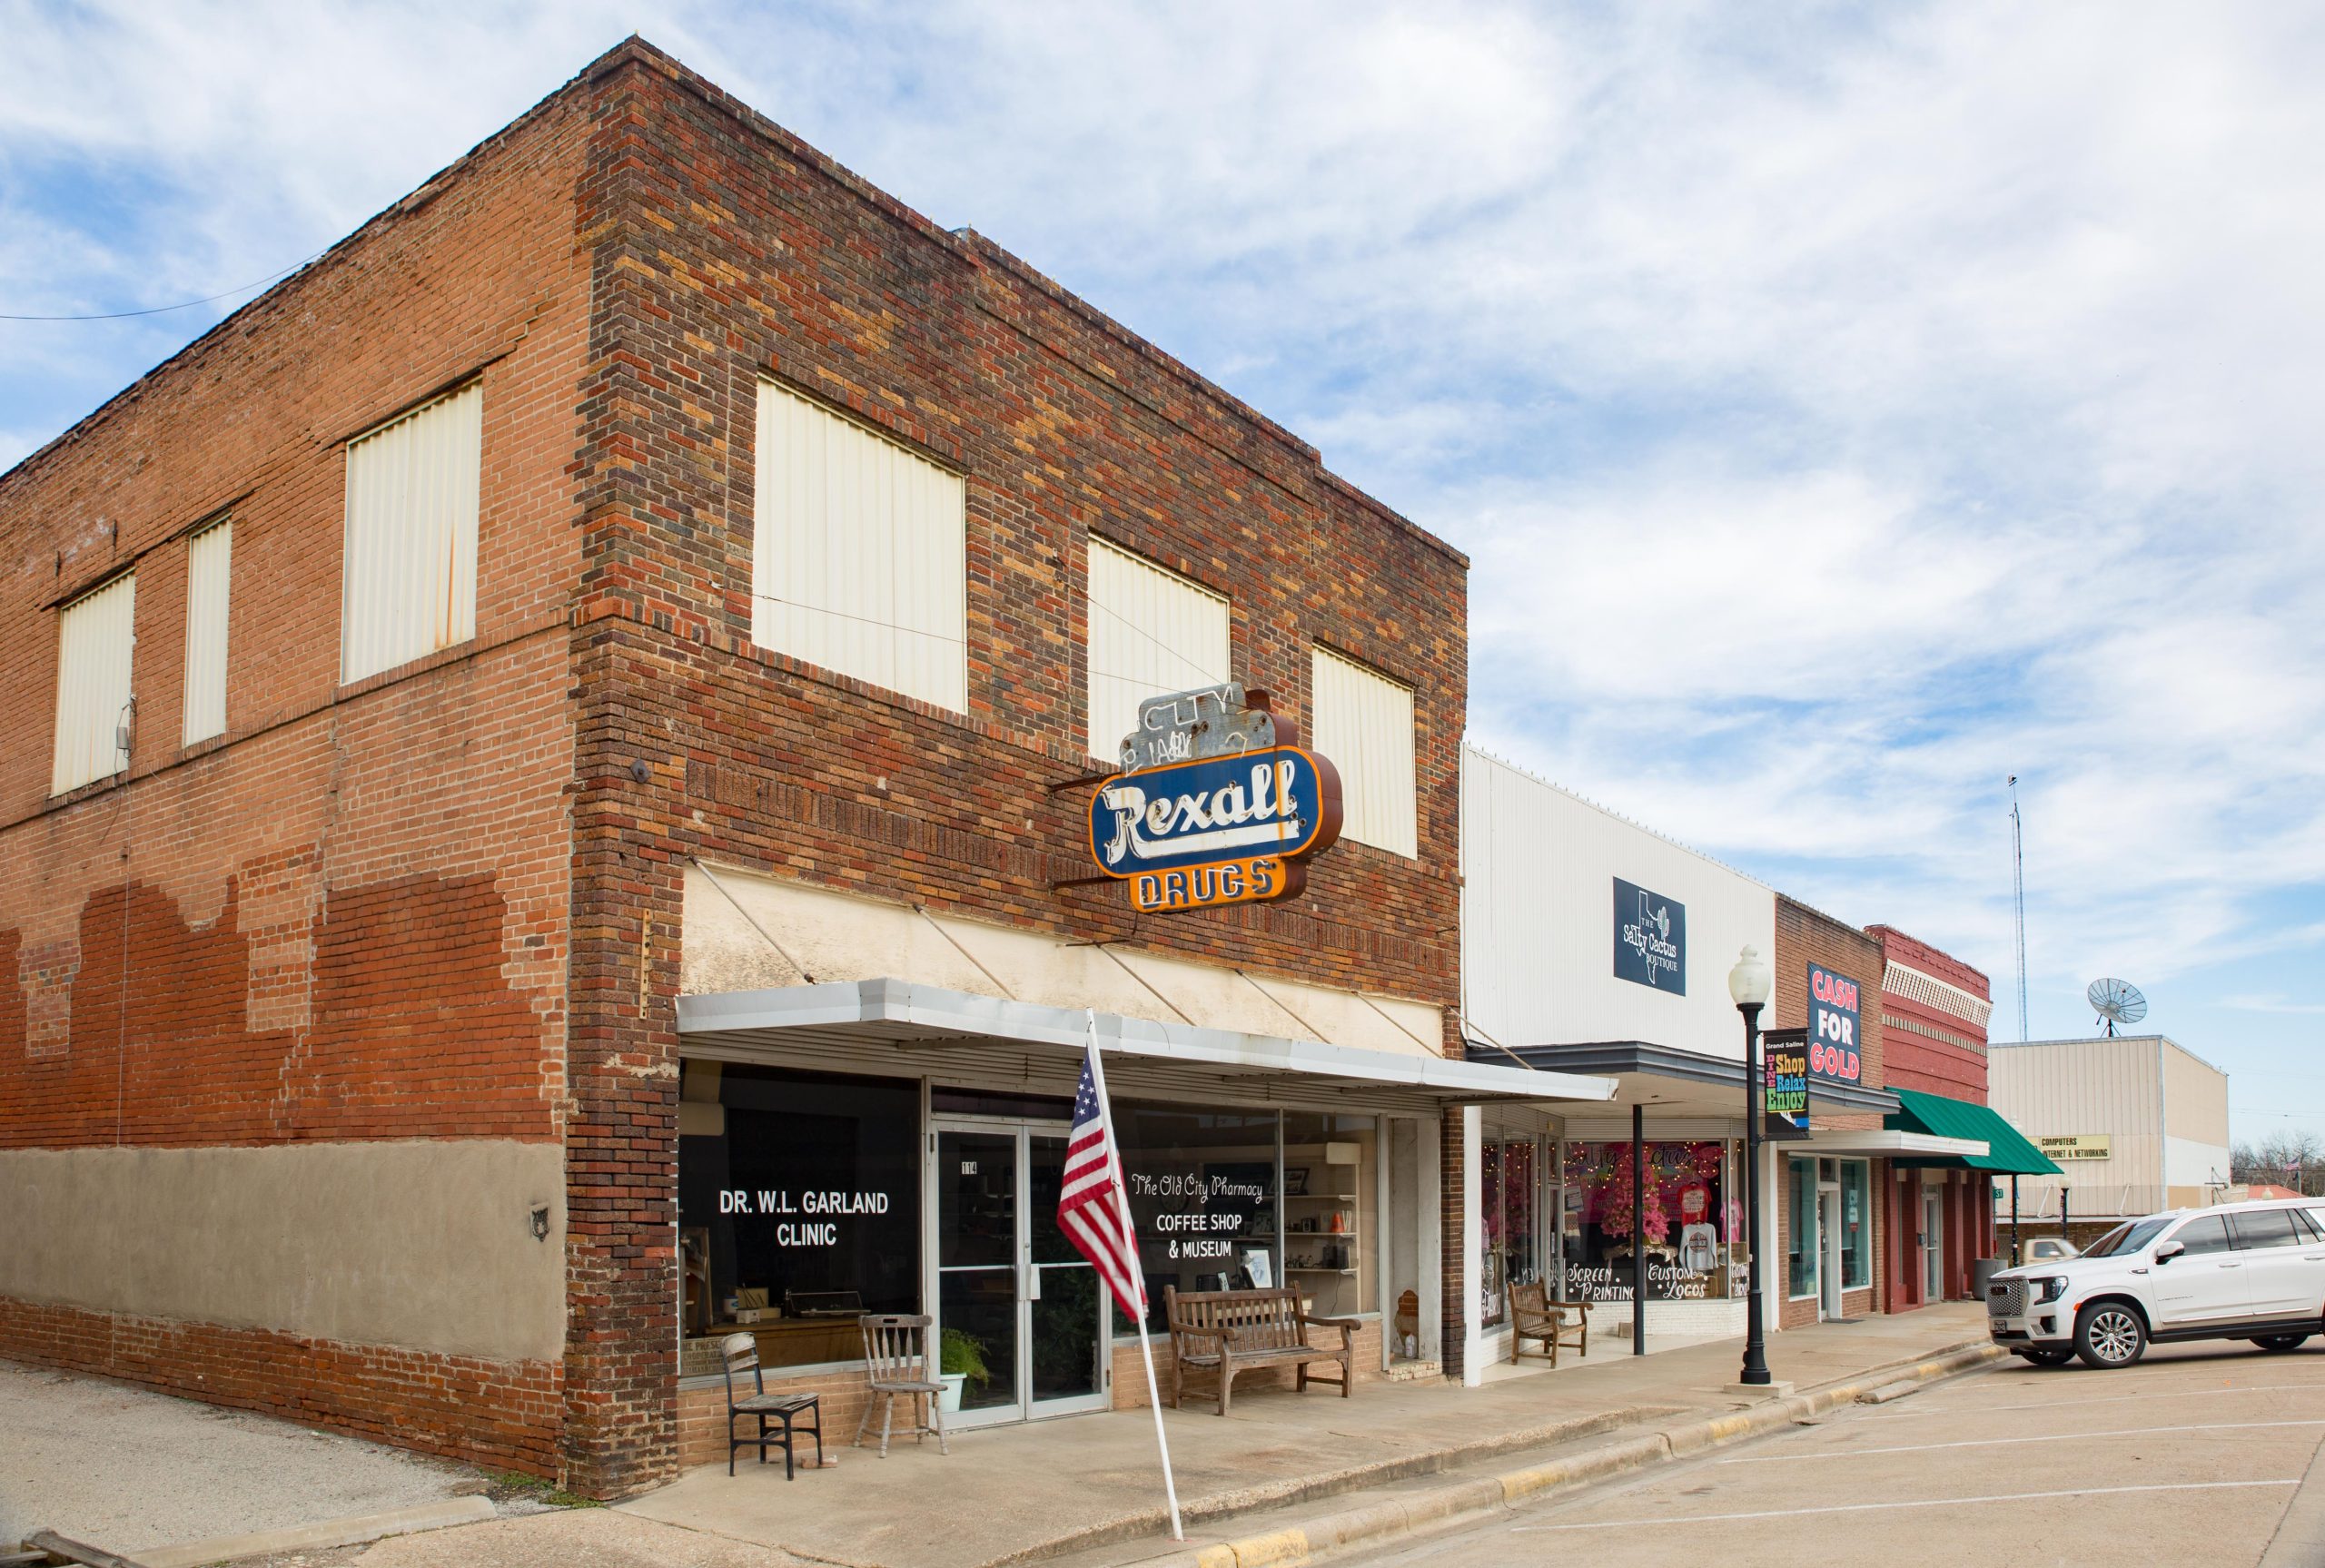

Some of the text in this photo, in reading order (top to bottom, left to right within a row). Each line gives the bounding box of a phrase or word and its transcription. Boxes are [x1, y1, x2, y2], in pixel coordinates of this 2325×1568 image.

[1101, 760, 1300, 866] Rexall
[1139, 859, 1273, 911] DRUGS
[1641, 918, 1654, 929] THE
[1623, 924, 1677, 958] Salty Cactus
[1646, 953, 1677, 971] BOUTIQUE
[1811, 970, 1857, 1012] CASH
[1818, 1009, 1853, 1045] FOR
[1766, 1054, 1776, 1088] DINE
[1776, 1053, 1806, 1077] Shop
[1810, 1042, 1860, 1080] GOLD
[1776, 1075, 1806, 1091] Relax
[1766, 1088, 1806, 1110] Enjoy
[2041, 1138, 2077, 1147] COMPUTERS
[2042, 1149, 2066, 1159] INTERNET
[2074, 1149, 2108, 1158] NETWORKING
[1132, 1173, 1262, 1204] The Old City Pharmacy
[719, 1190, 889, 1214] DR. W.L. GARLAND
[1156, 1214, 1242, 1231] COFFEE SHOP
[777, 1223, 836, 1247] CLINIC
[1168, 1240, 1232, 1258] & MUSEUM
